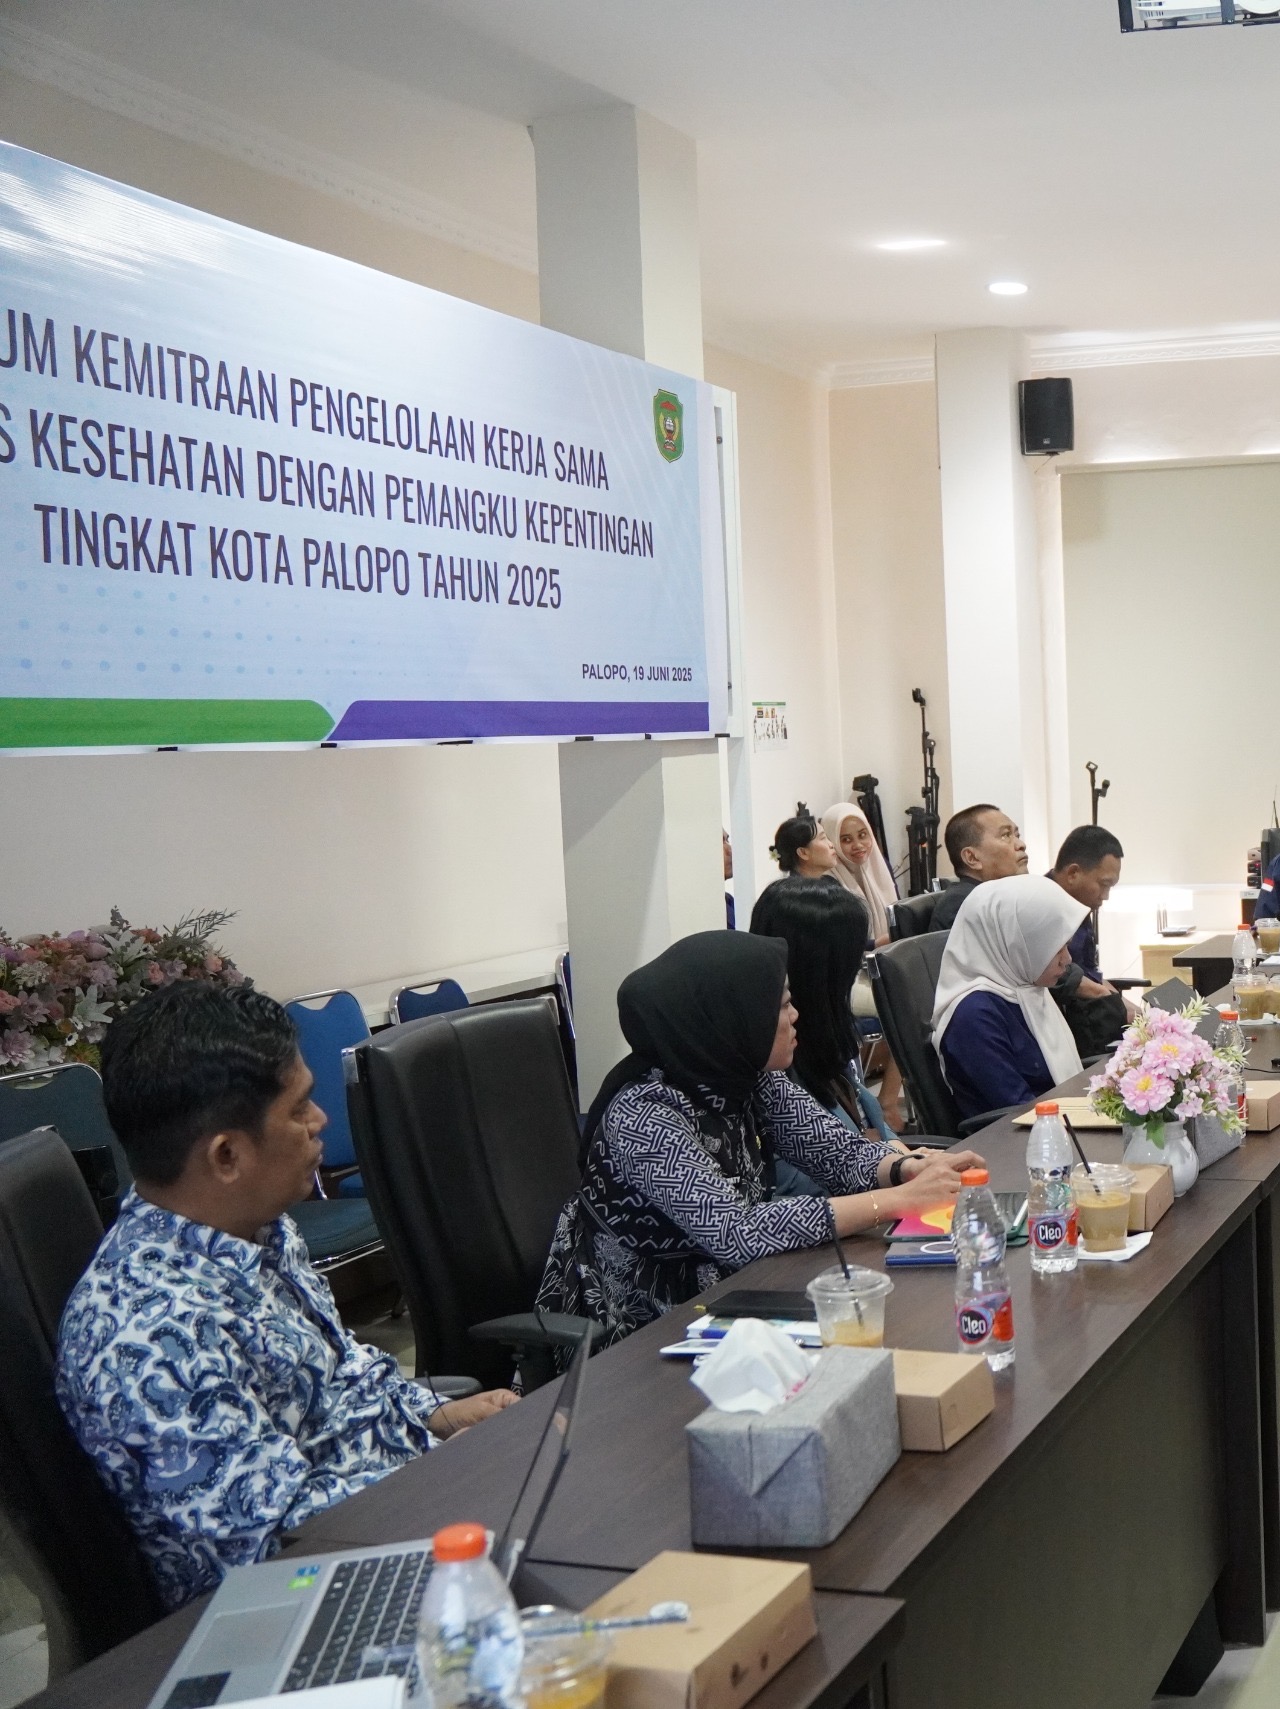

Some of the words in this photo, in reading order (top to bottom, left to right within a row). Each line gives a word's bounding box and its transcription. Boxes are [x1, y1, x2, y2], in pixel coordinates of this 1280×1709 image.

[0, 309, 57, 377] UM
[74, 325, 278, 423] KEMITRAAN
[290, 378, 475, 463] PENGELOLAAN
[483, 423, 547, 478] KERJA
[554, 441, 609, 490] SAMA
[0, 402, 16, 463] S
[30, 408, 244, 498] KESEHATAN
[257, 450, 375, 517] DENGAN
[385, 474, 517, 538] PEMANGKU
[525, 499, 654, 558] KEPENTINGAN
[34, 503, 196, 576] TINGKAT
[209, 526, 293, 586] KOTA
[304, 537, 410, 596] PALOPO
[418, 552, 499, 603] TAHUN
[507, 563, 562, 609] 2025
[582, 663, 630, 683] PALOPO,
[633, 665, 644, 680] 19
[647, 666, 669, 681] JUNI
[672, 667, 692, 681] 2025
[1039, 1221, 1062, 1240] Cleo
[961, 1315, 987, 1335] Cleo
